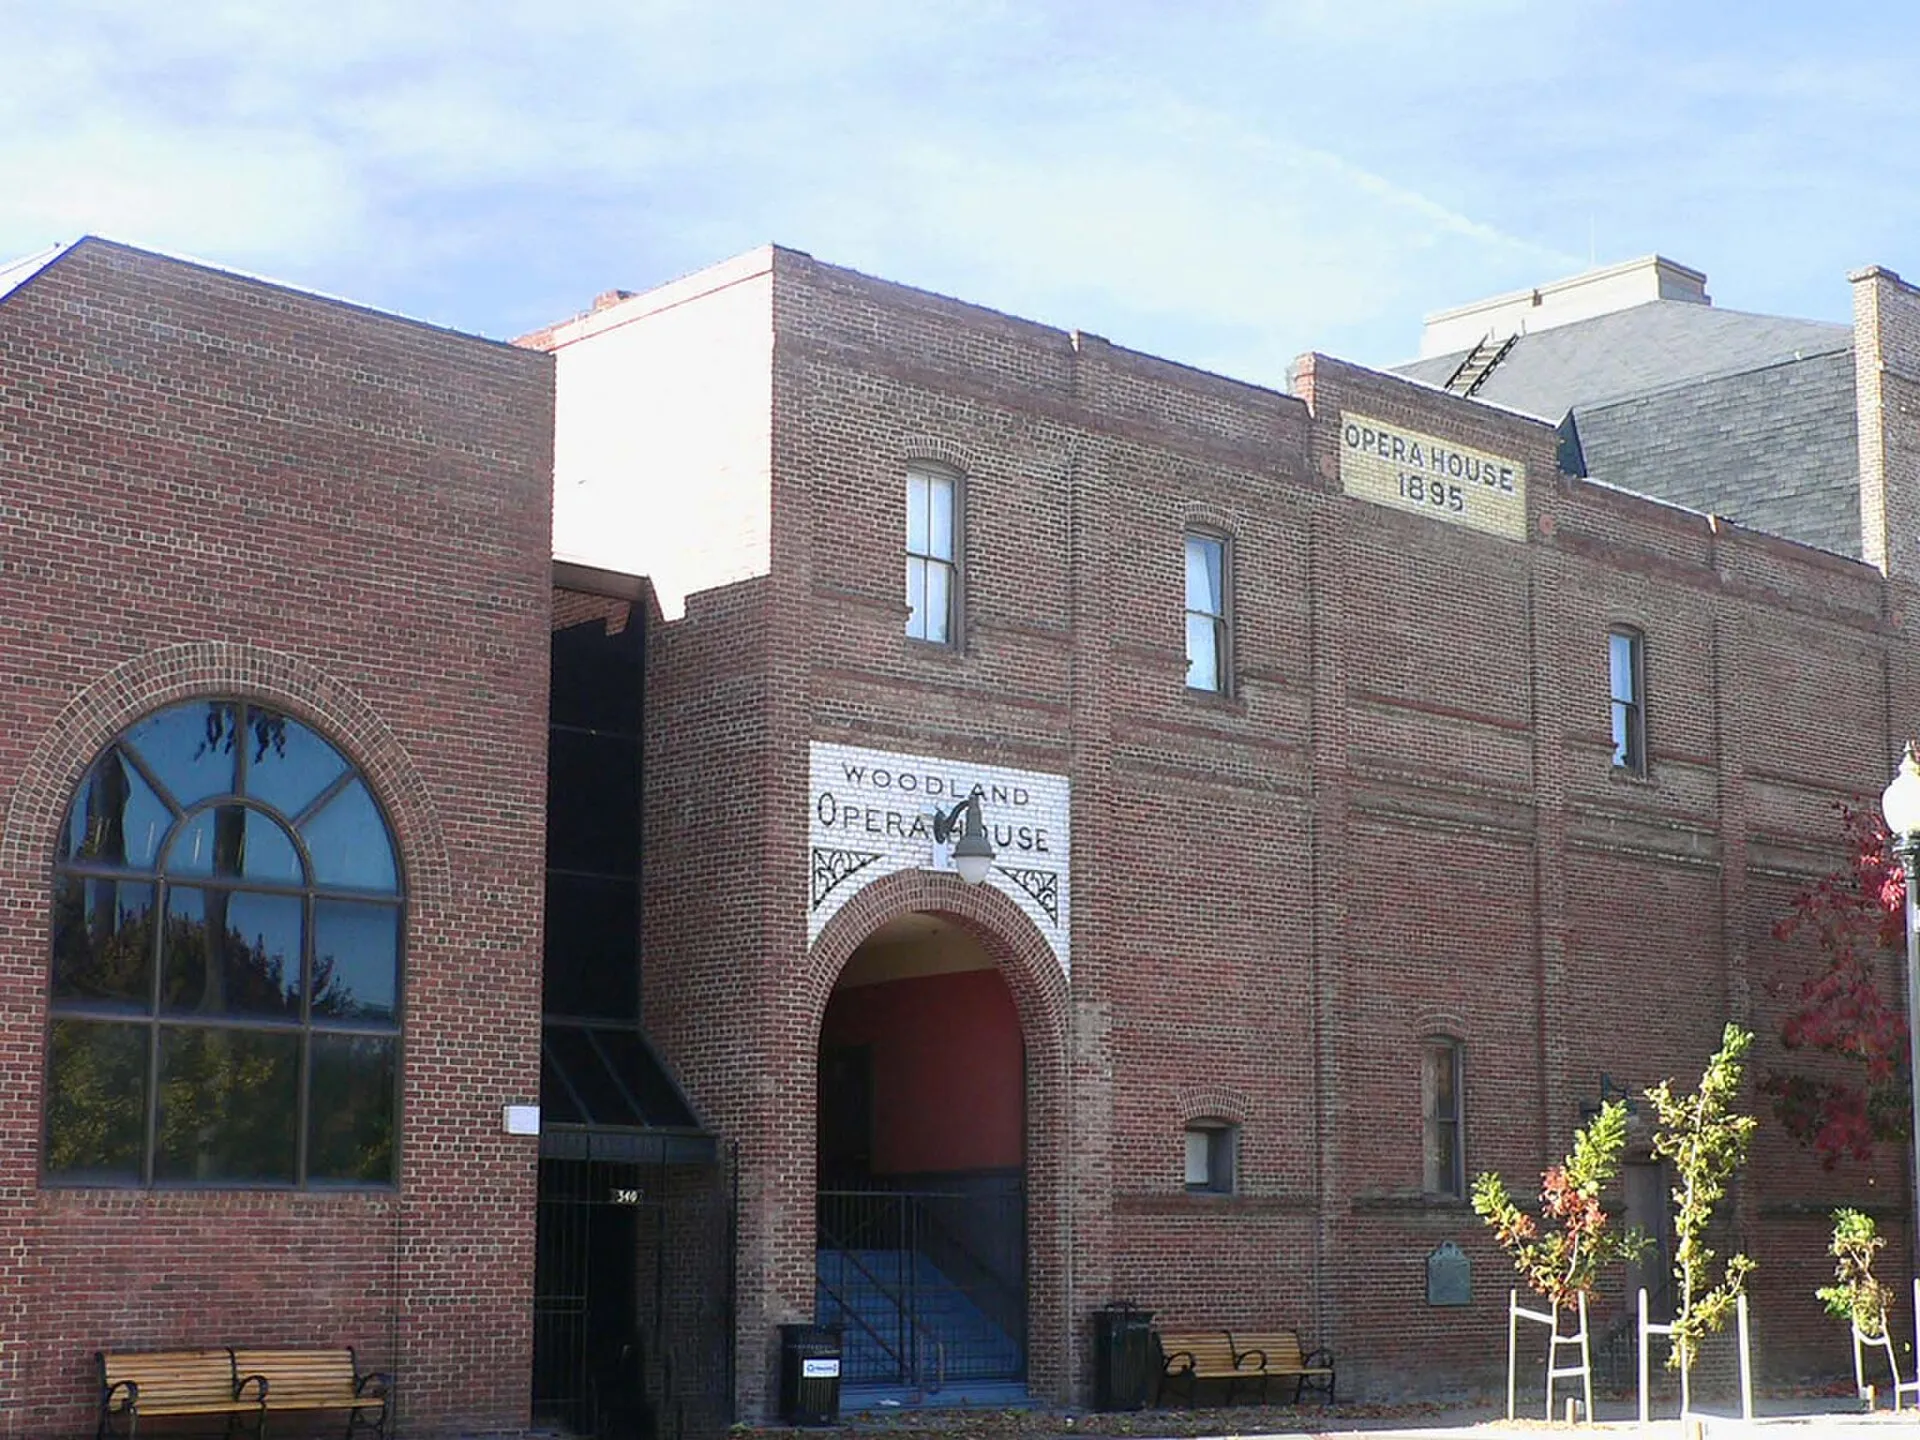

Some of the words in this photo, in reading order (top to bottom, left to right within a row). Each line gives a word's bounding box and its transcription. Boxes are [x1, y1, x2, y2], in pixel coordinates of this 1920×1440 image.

[1345, 425, 1424, 467] OPERA
[1431, 447, 1514, 492] HOUSE
[1398, 472, 1464, 512] 1895
[842, 762, 1030, 806] WOODLAND
[818, 792, 930, 840] OPERA
